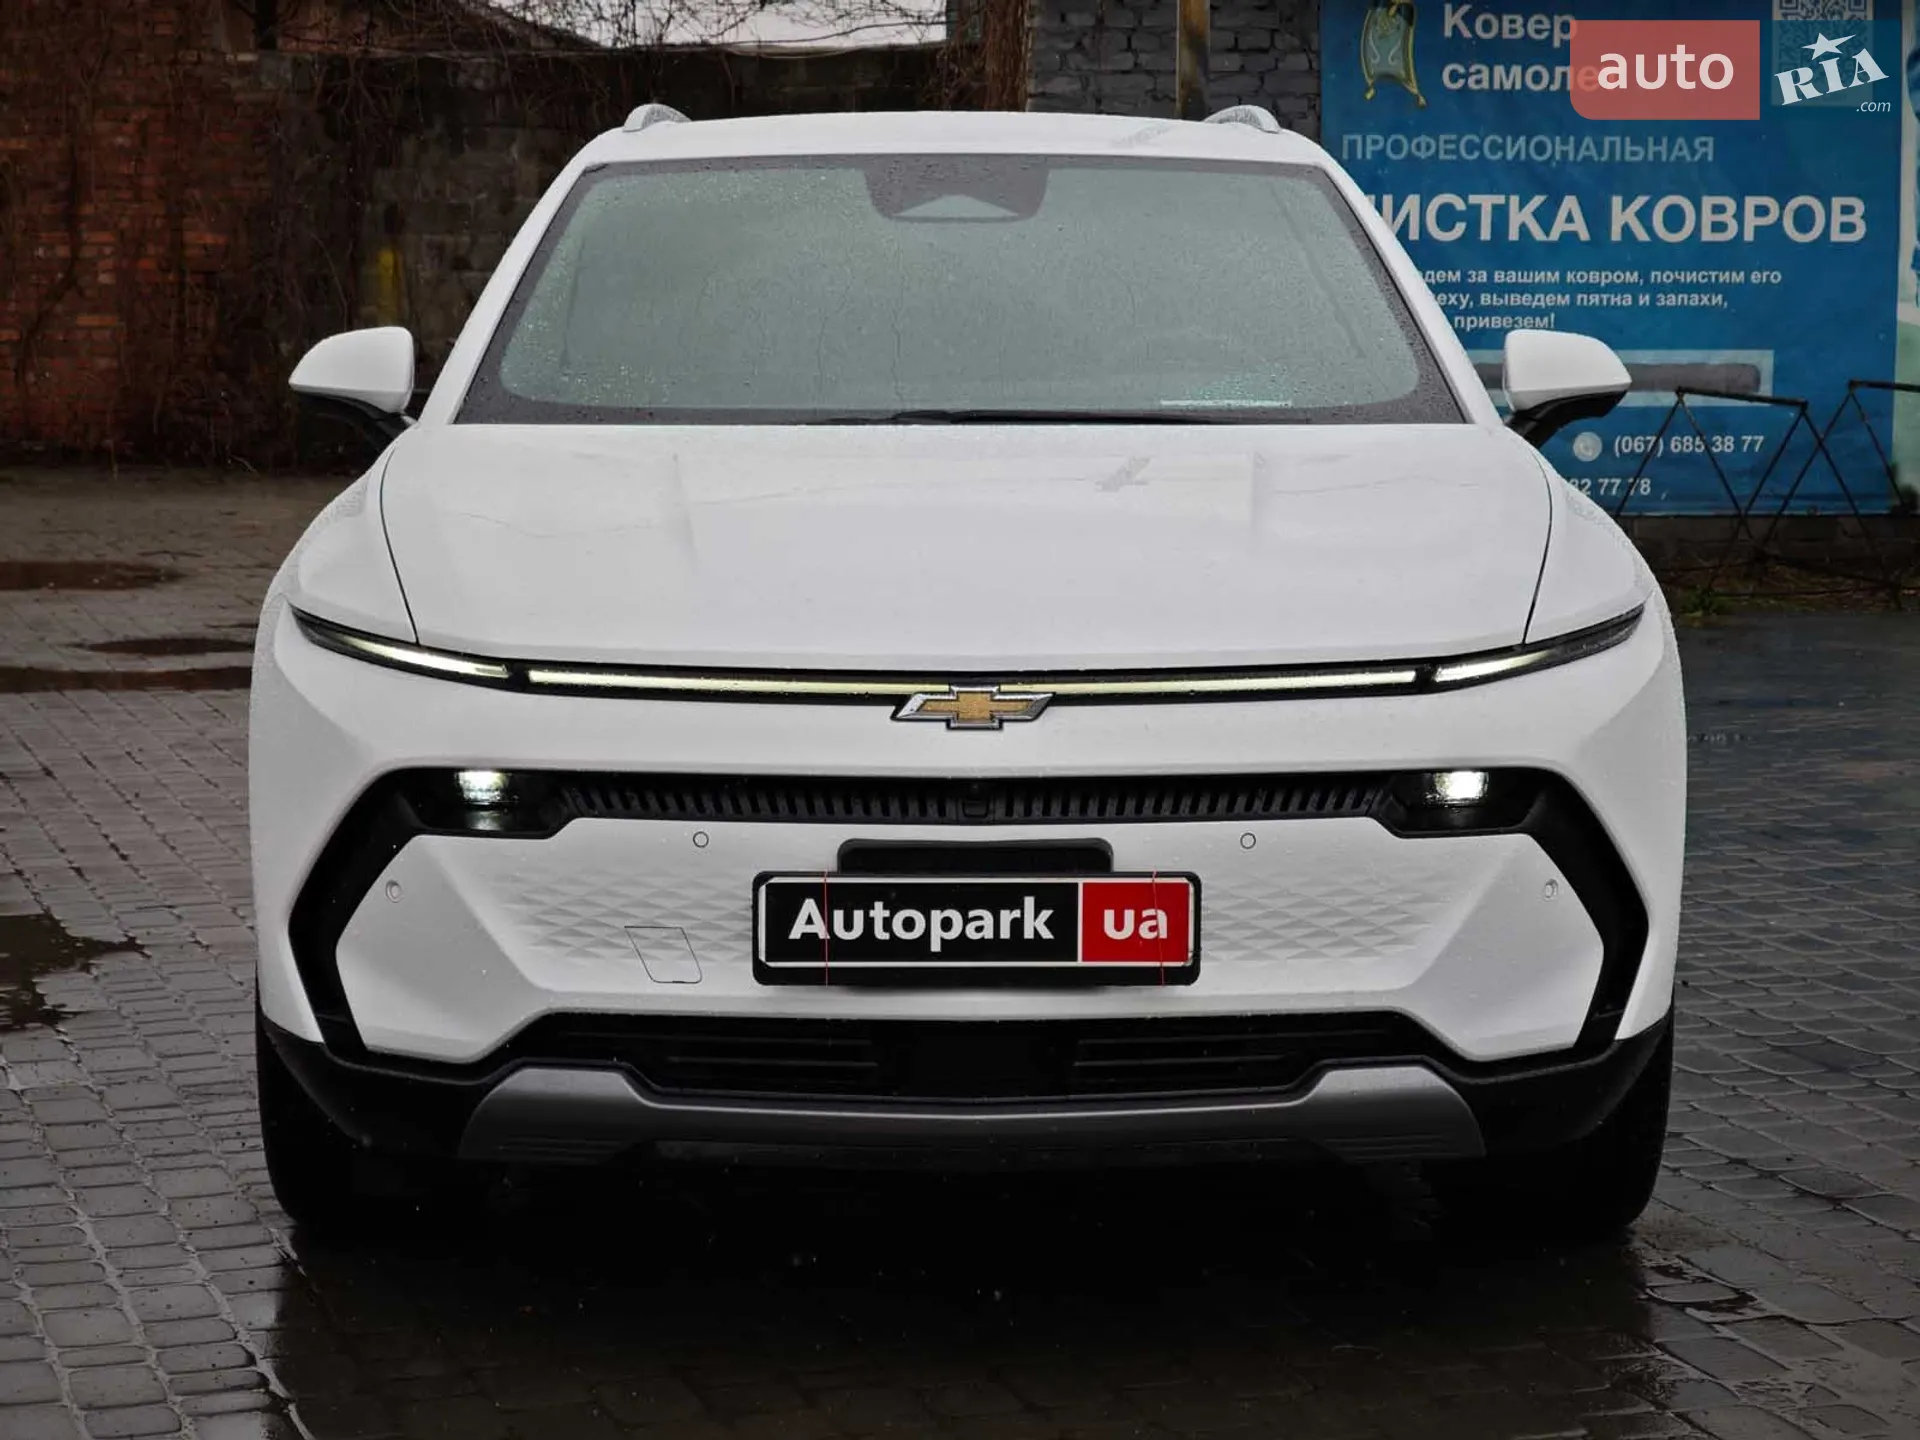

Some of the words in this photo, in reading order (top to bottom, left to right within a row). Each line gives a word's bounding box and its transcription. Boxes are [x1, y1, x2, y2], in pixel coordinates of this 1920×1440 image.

[1443, 3, 1578, 48] Ковер
[1442, 62, 1606, 91] самоле
[1342, 134, 1714, 162] ПРОФЕССИОНАЛЬНАЯ
[1365, 193, 1591, 242] ИСТКА
[1610, 194, 1867, 243] КОВРОВ
[1419, 270, 1461, 285] дем
[1468, 270, 1487, 284] за
[1494, 270, 1559, 284] вашим
[1566, 270, 1644, 287] ковром,
[1651, 270, 1745, 284] почистим
[1750, 270, 1782, 284] его
[1433, 293, 1474, 309] еху,
[1480, 293, 1570, 308] выведем
[1576, 293, 1632, 307] пятна
[1639, 293, 1650, 307] и
[1655, 293, 1728, 309] запахи,
[1454, 312, 1556, 331] привезем!
[1614, 435, 1664, 457] (067)
[1670, 435, 1705, 453] 685
[1711, 435, 1735, 453] 38
[1741, 435, 1764, 453] 77
[1598, 478, 1622, 495] 77
[788, 896, 1055, 952] Autopark
[1103, 908, 1168, 940] ua
